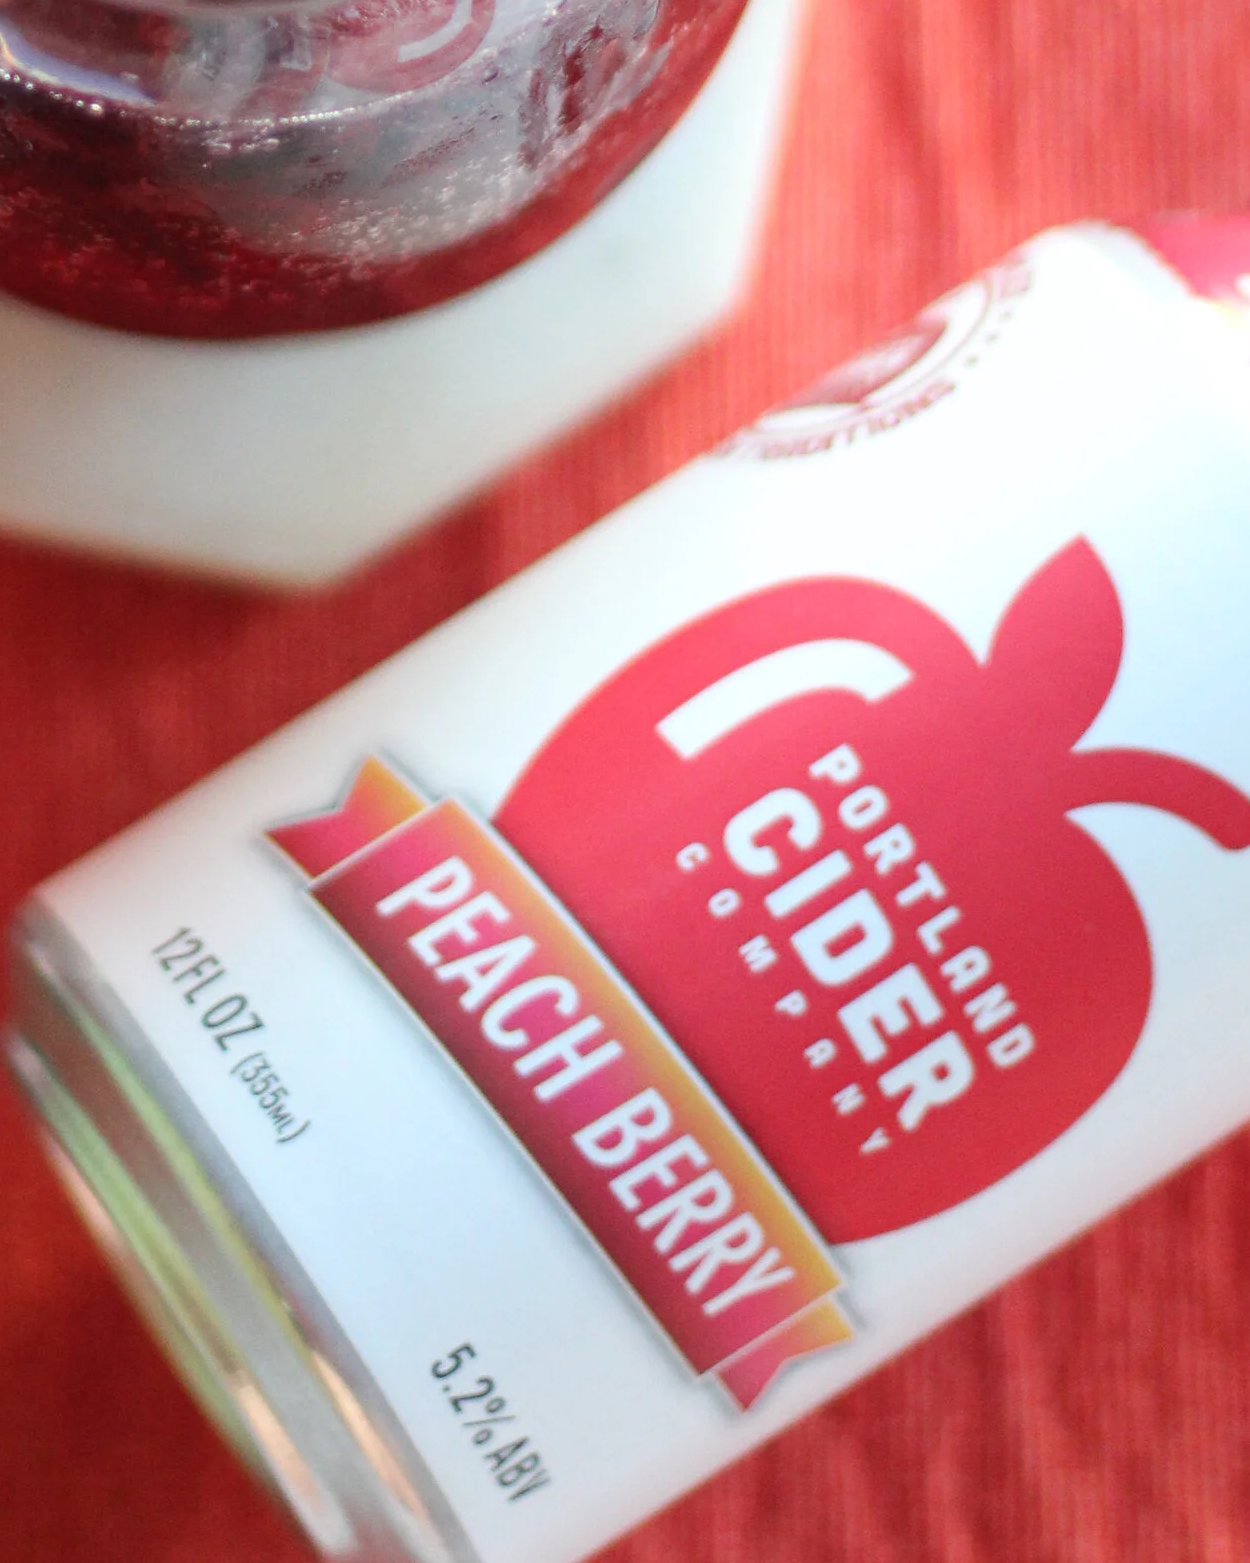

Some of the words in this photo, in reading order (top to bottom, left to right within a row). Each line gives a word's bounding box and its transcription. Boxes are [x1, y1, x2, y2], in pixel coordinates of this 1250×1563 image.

[201, 993, 266, 1053] OZ
[675, 841, 891, 1157] COMPANY
[723, 786, 976, 1133] CIDER
[808, 742, 1036, 1069] PORTLAND
[229, 1051, 312, 1144] (355ML)
[375, 854, 625, 1104] PEACH
[571, 1086, 797, 1318] BERRY
